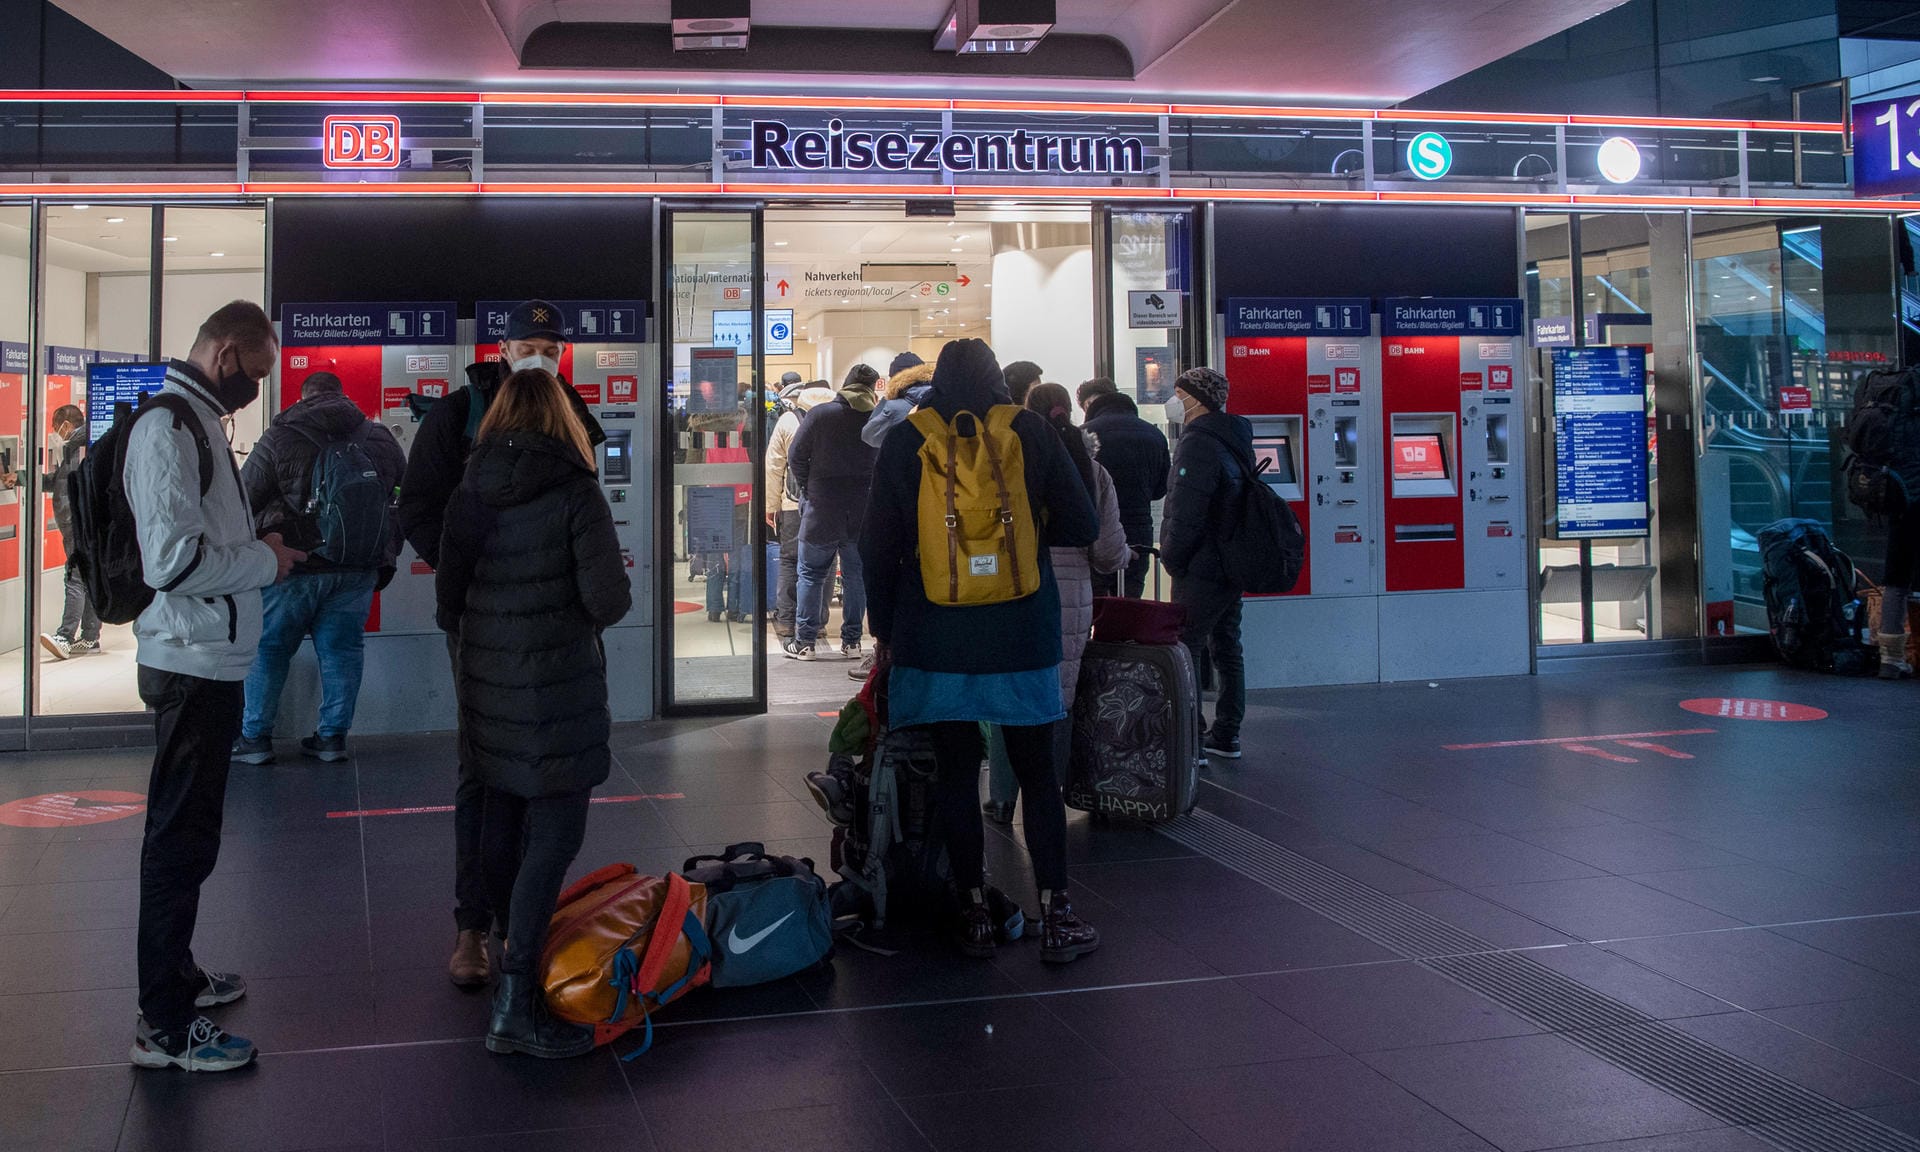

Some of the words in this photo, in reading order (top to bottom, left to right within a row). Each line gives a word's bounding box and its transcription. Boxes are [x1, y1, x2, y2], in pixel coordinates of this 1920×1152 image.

[333, 124, 392, 162] DB
[750, 117, 1145, 174] Reisezentrum
[804, 287, 832, 298] tickets
[833, 286, 894, 300] regional/local
[293, 313, 370, 327] Fahrkarten
[1239, 306, 1302, 320] Fahrkarten
[1395, 306, 1456, 320] Fahrkarten
[293, 328, 381, 339] Tickets/Billets/Biglietti
[1071, 791, 1095, 810] BE
[1099, 795, 1168, 819] HAPPY!
